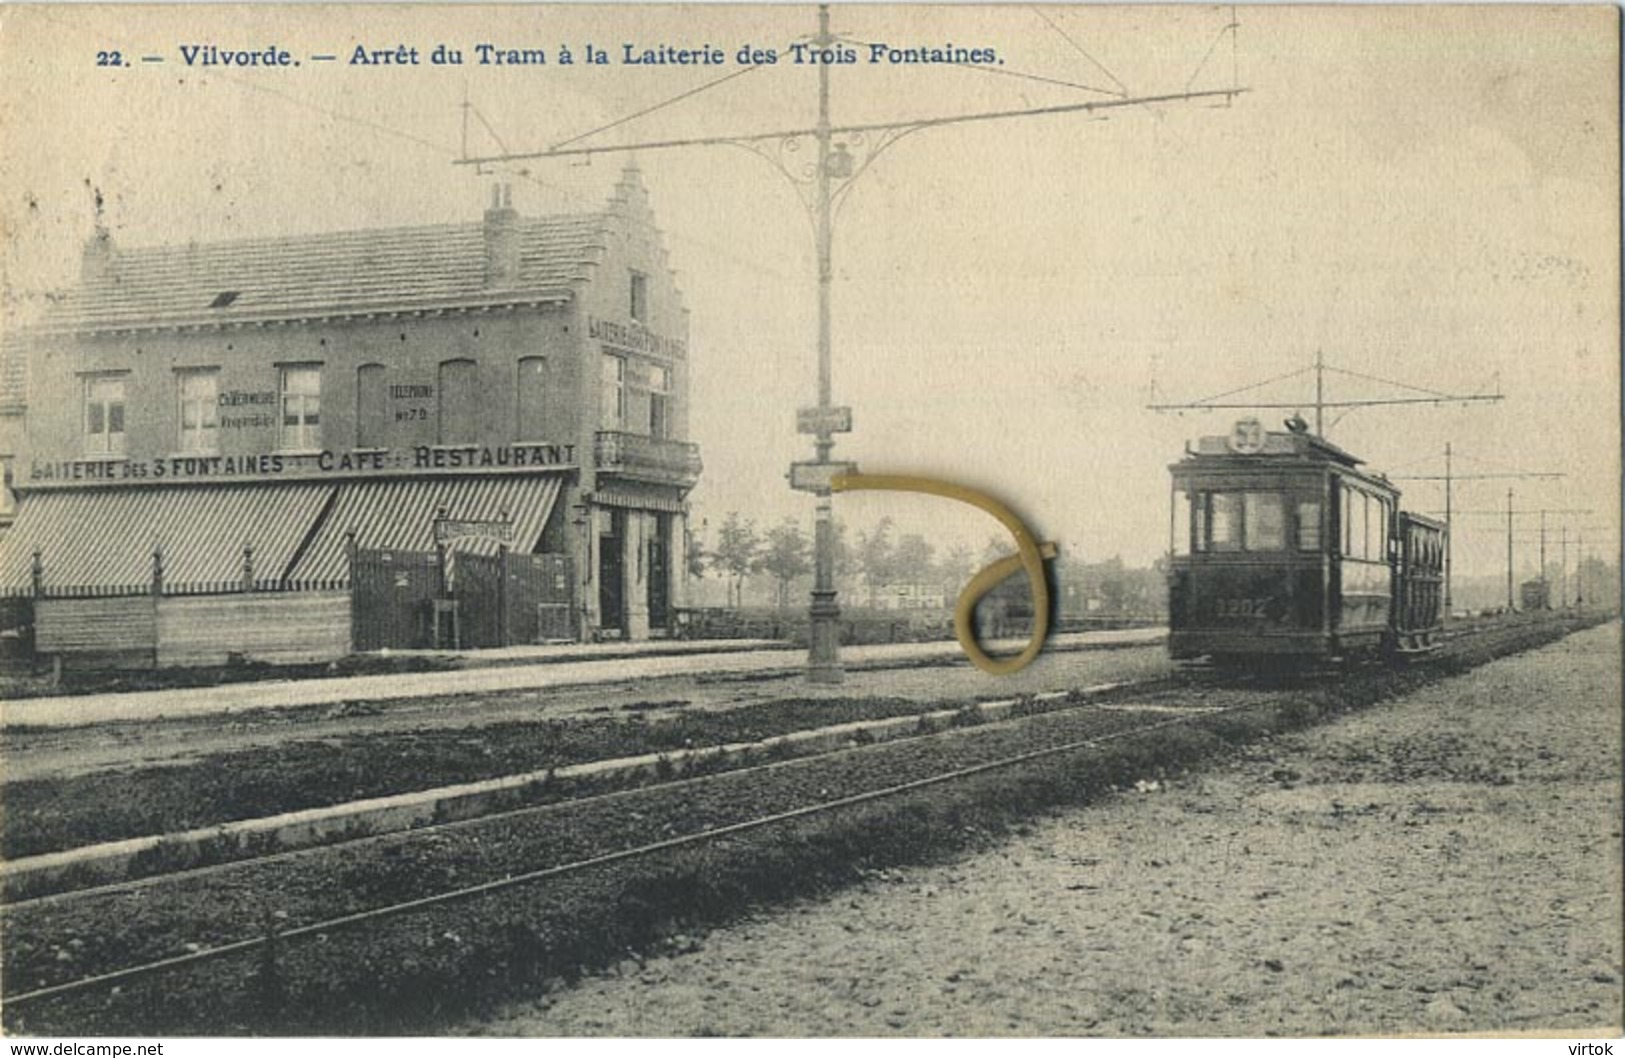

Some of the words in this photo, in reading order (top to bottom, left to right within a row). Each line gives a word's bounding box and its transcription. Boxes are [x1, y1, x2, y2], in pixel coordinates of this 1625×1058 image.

[30, 459, 115, 479] LAITERIE
[123, 462, 147, 478] DES
[153, 459, 166, 477] 3
[171, 455, 284, 476] FONTAINES
[414, 445, 575, 468] RESTAURANT
